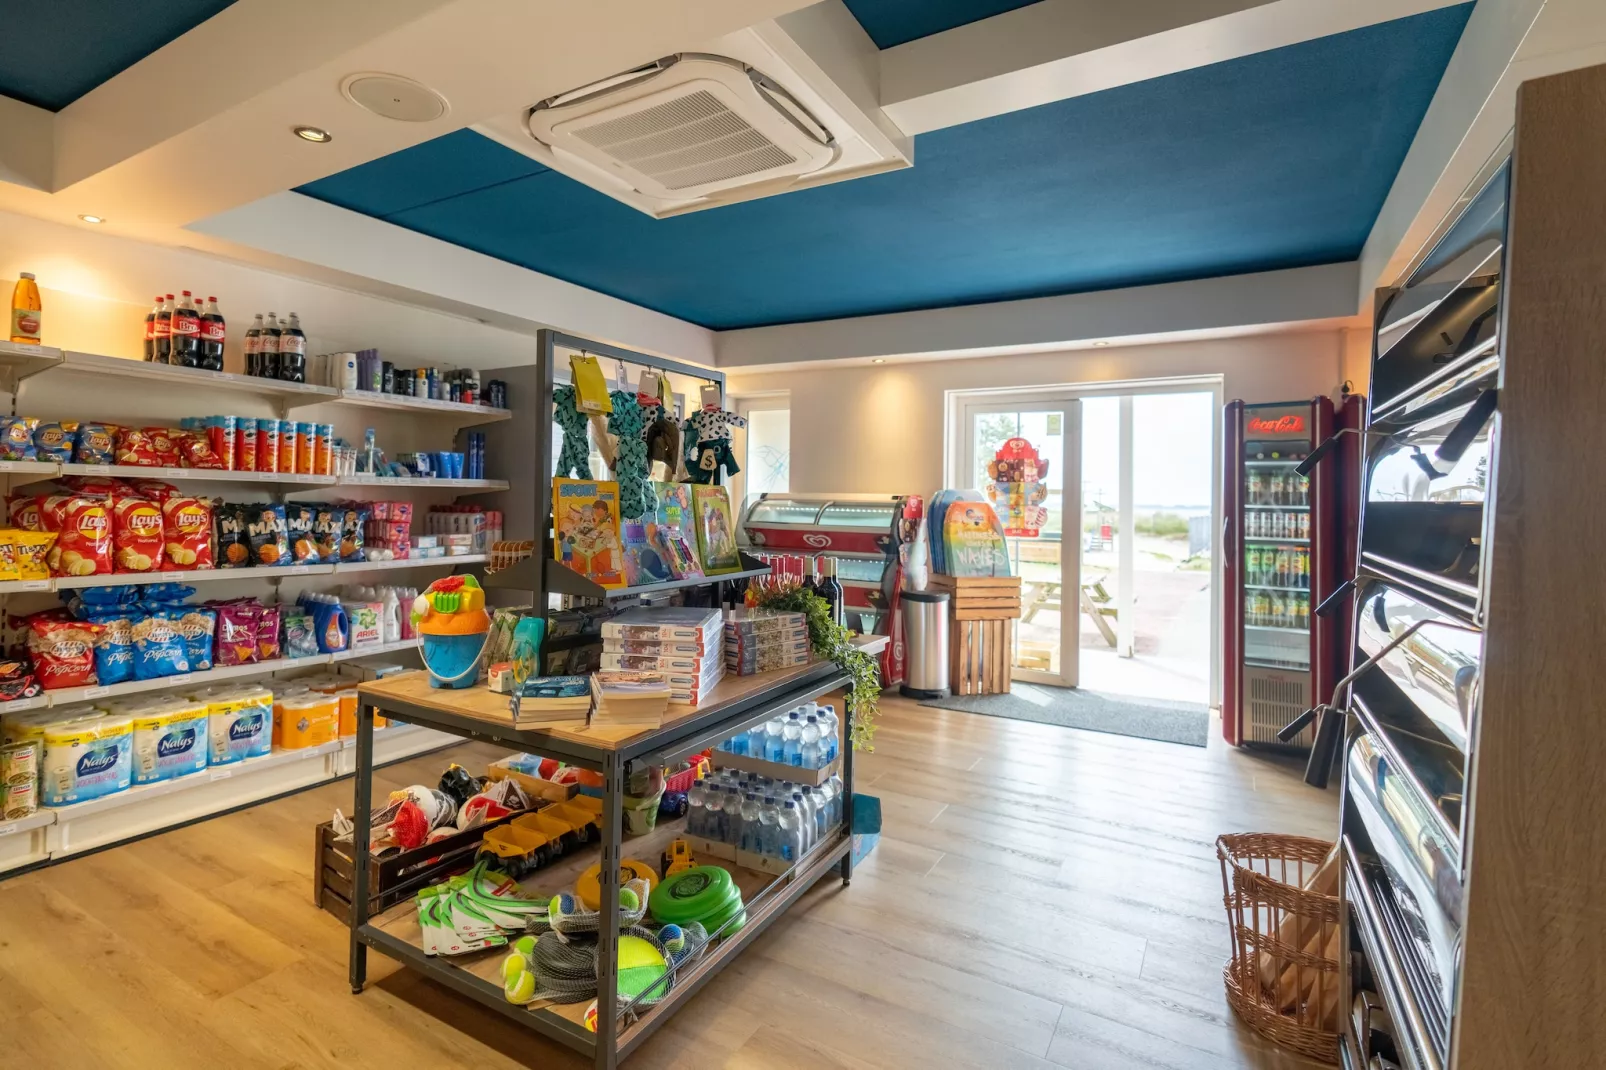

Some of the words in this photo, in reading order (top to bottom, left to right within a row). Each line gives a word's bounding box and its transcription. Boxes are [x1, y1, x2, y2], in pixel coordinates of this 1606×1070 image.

[1247, 415, 1304, 433] Coca-Cola
[356, 629, 380, 639] ARIEL
[233, 719, 261, 735] Nalys
[161, 736, 194, 751] Nalys
[80, 753, 118, 770] Nalys
